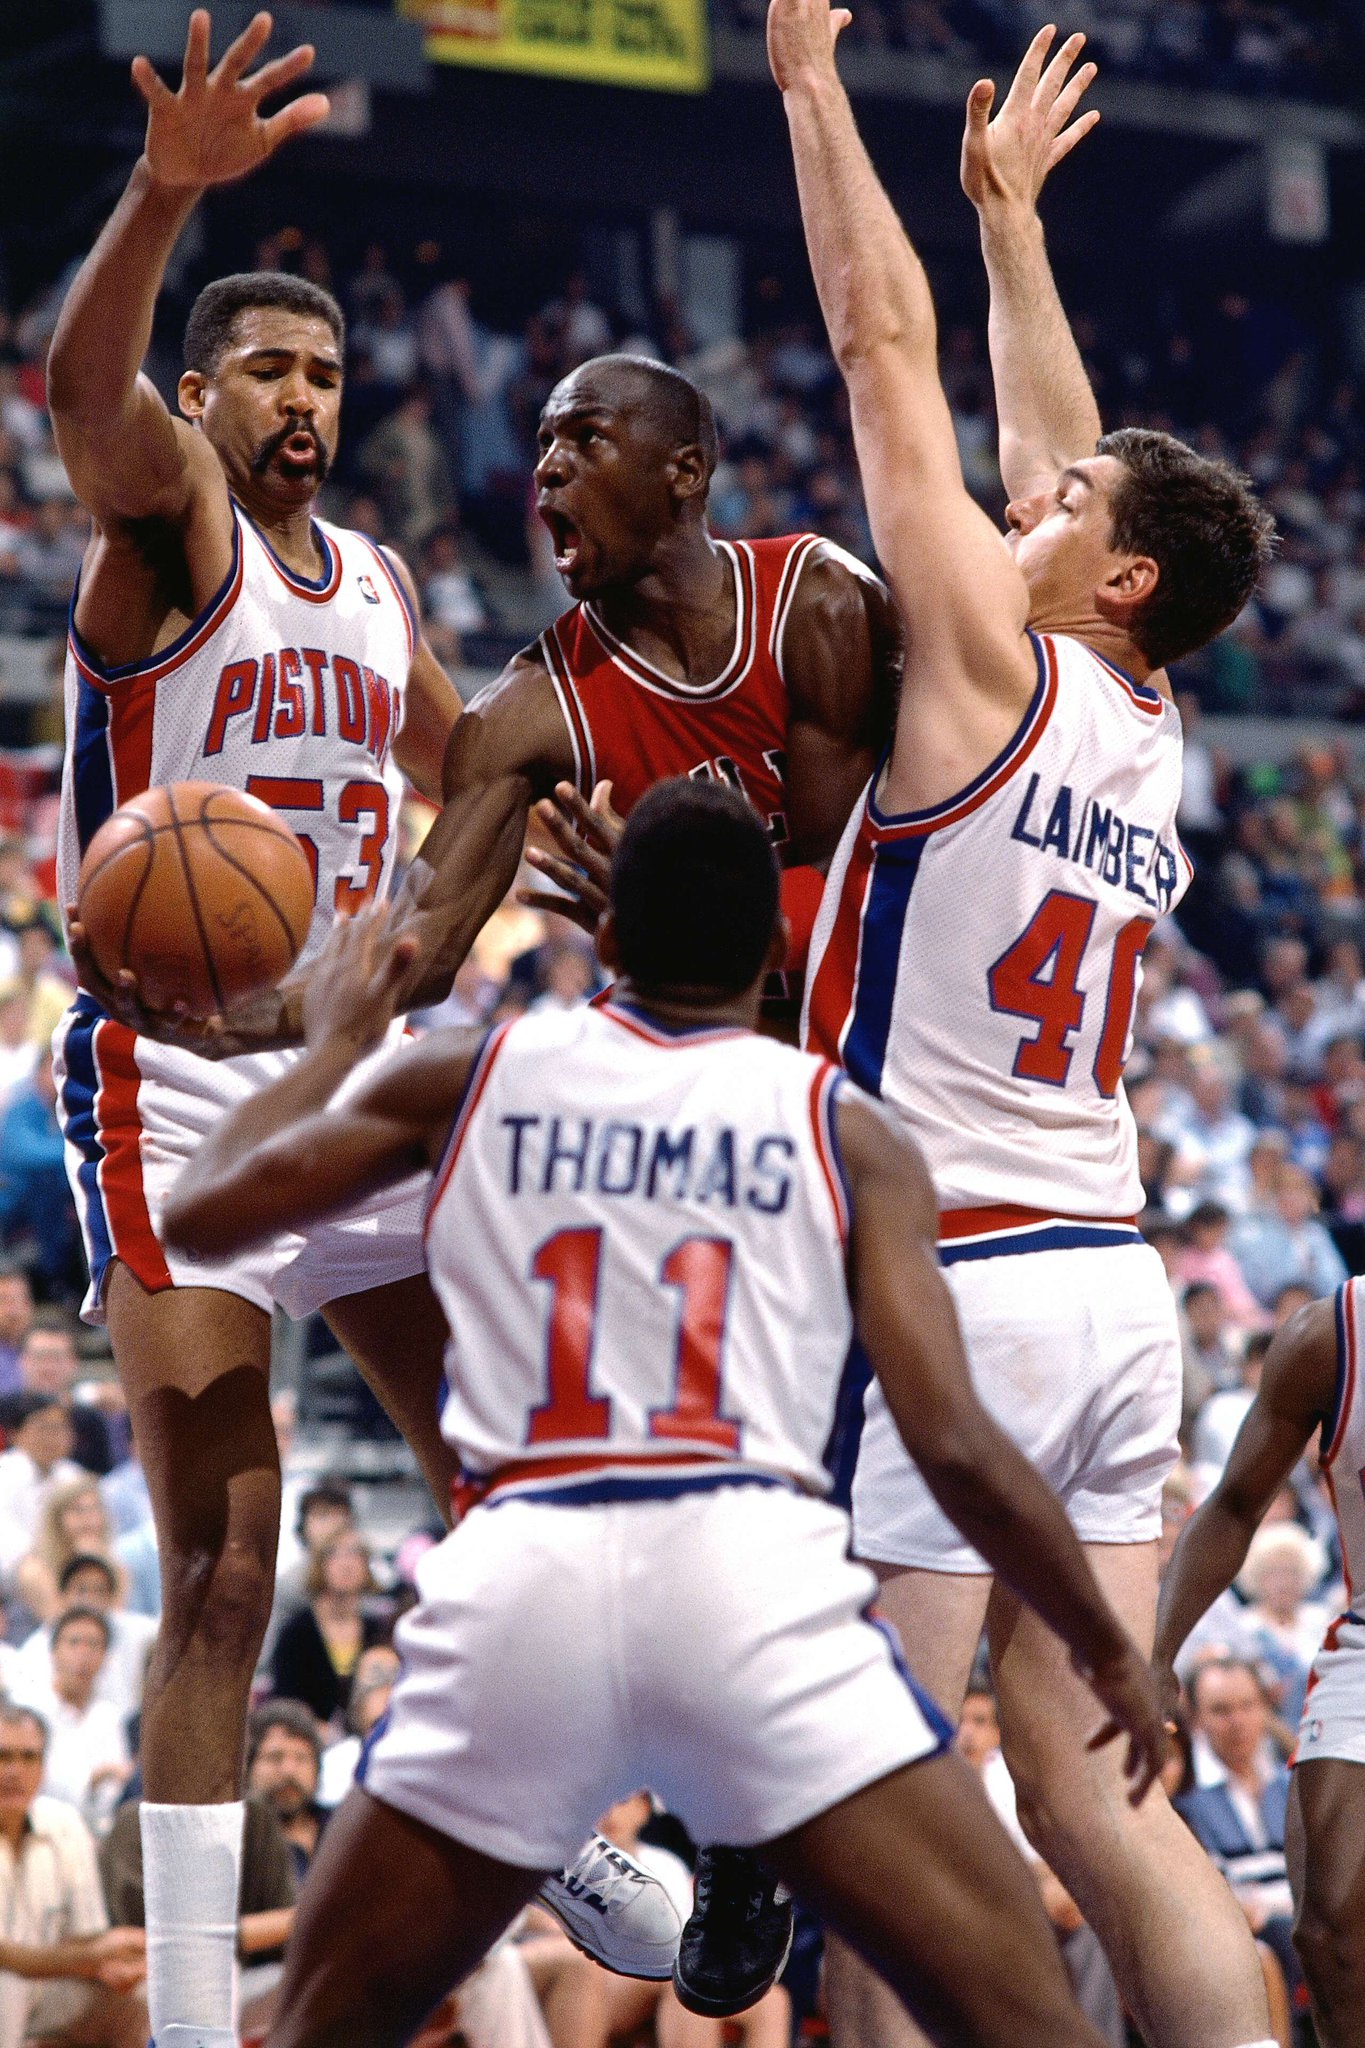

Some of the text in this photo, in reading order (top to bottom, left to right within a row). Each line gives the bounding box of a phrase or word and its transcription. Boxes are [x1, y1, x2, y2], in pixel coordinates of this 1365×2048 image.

[203, 647, 400, 778] PISTON
[502, 1113, 797, 1215] THOMAS
[526, 1225, 741, 1455] 11
